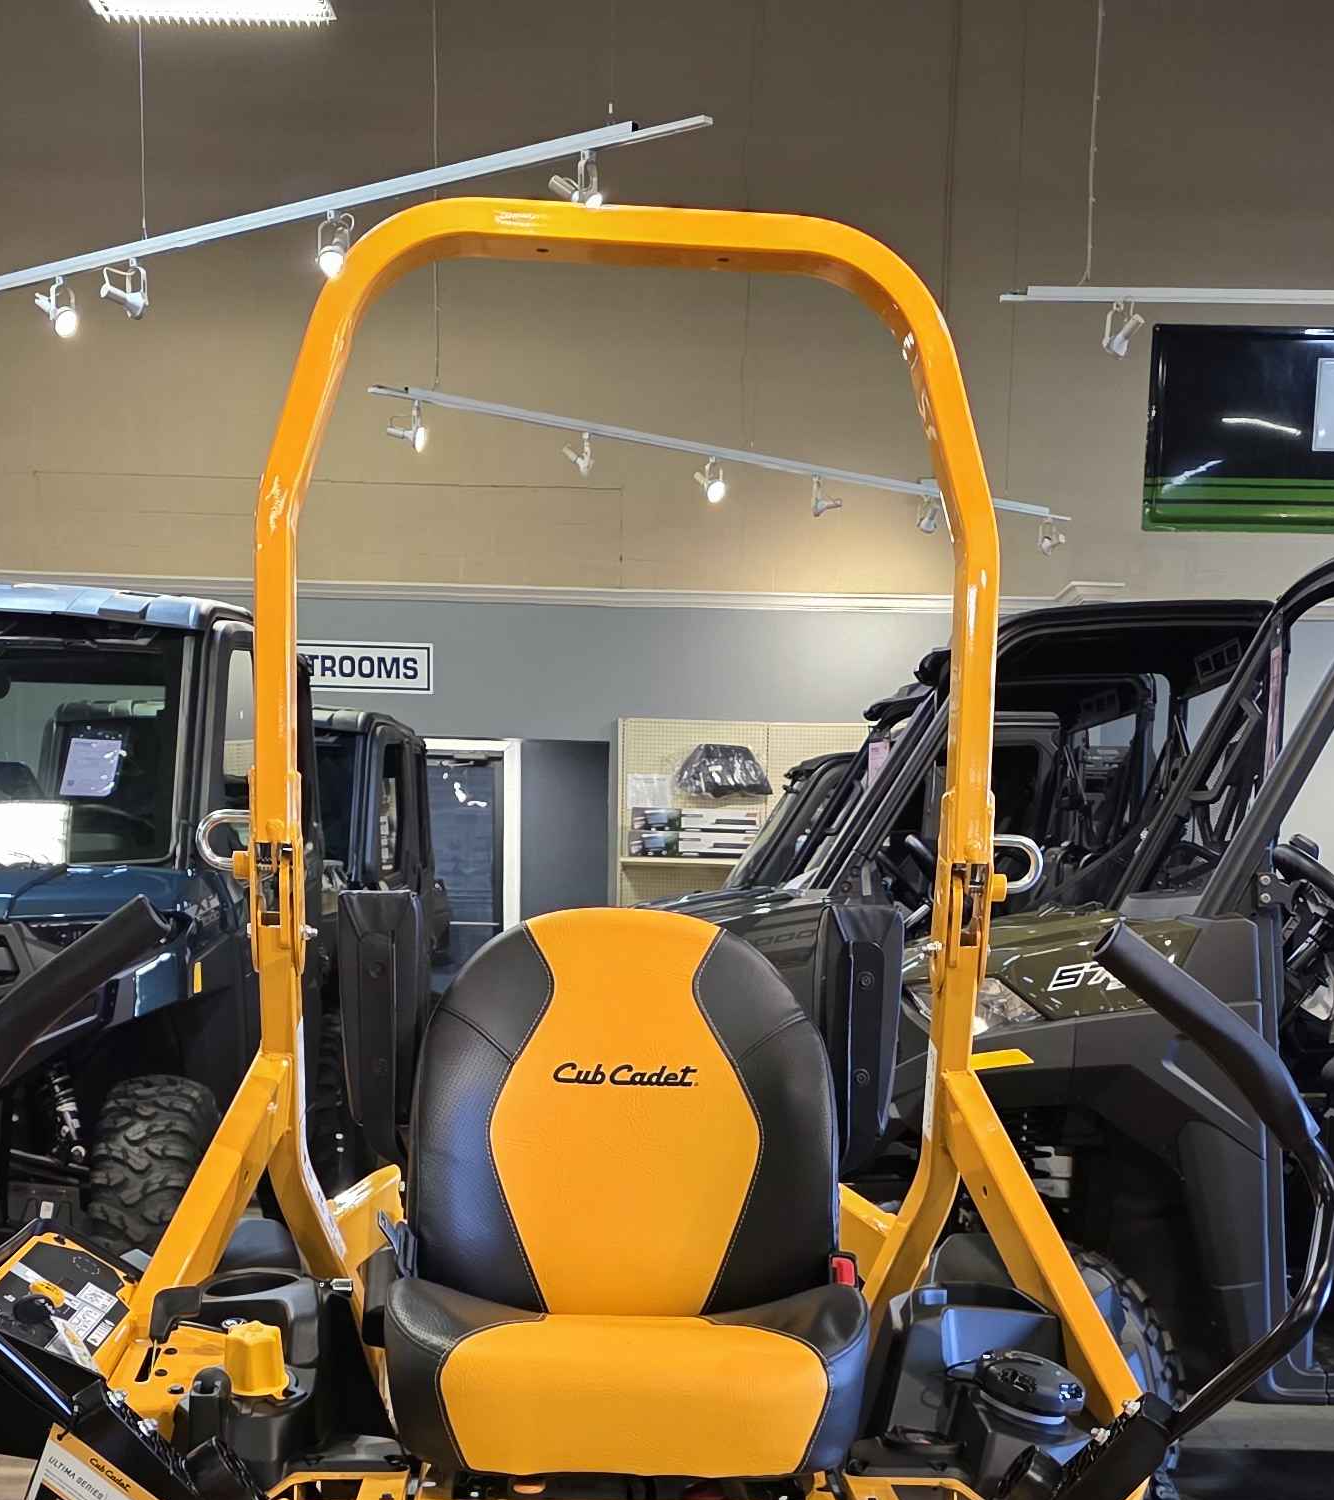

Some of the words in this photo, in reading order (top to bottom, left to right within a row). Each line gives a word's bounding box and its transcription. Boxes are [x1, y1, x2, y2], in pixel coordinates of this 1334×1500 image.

[307, 654, 419, 680] TROOMS
[1047, 961, 1108, 991] 57
[552, 1062, 606, 1085] Cub
[609, 1064, 698, 1087] Cadet
[48, 1456, 76, 1480] ULTIMA
[75, 1476, 104, 1500] SERIES
[89, 1457, 106, 1473] Cub
[105, 1469, 132, 1493] Cadet
